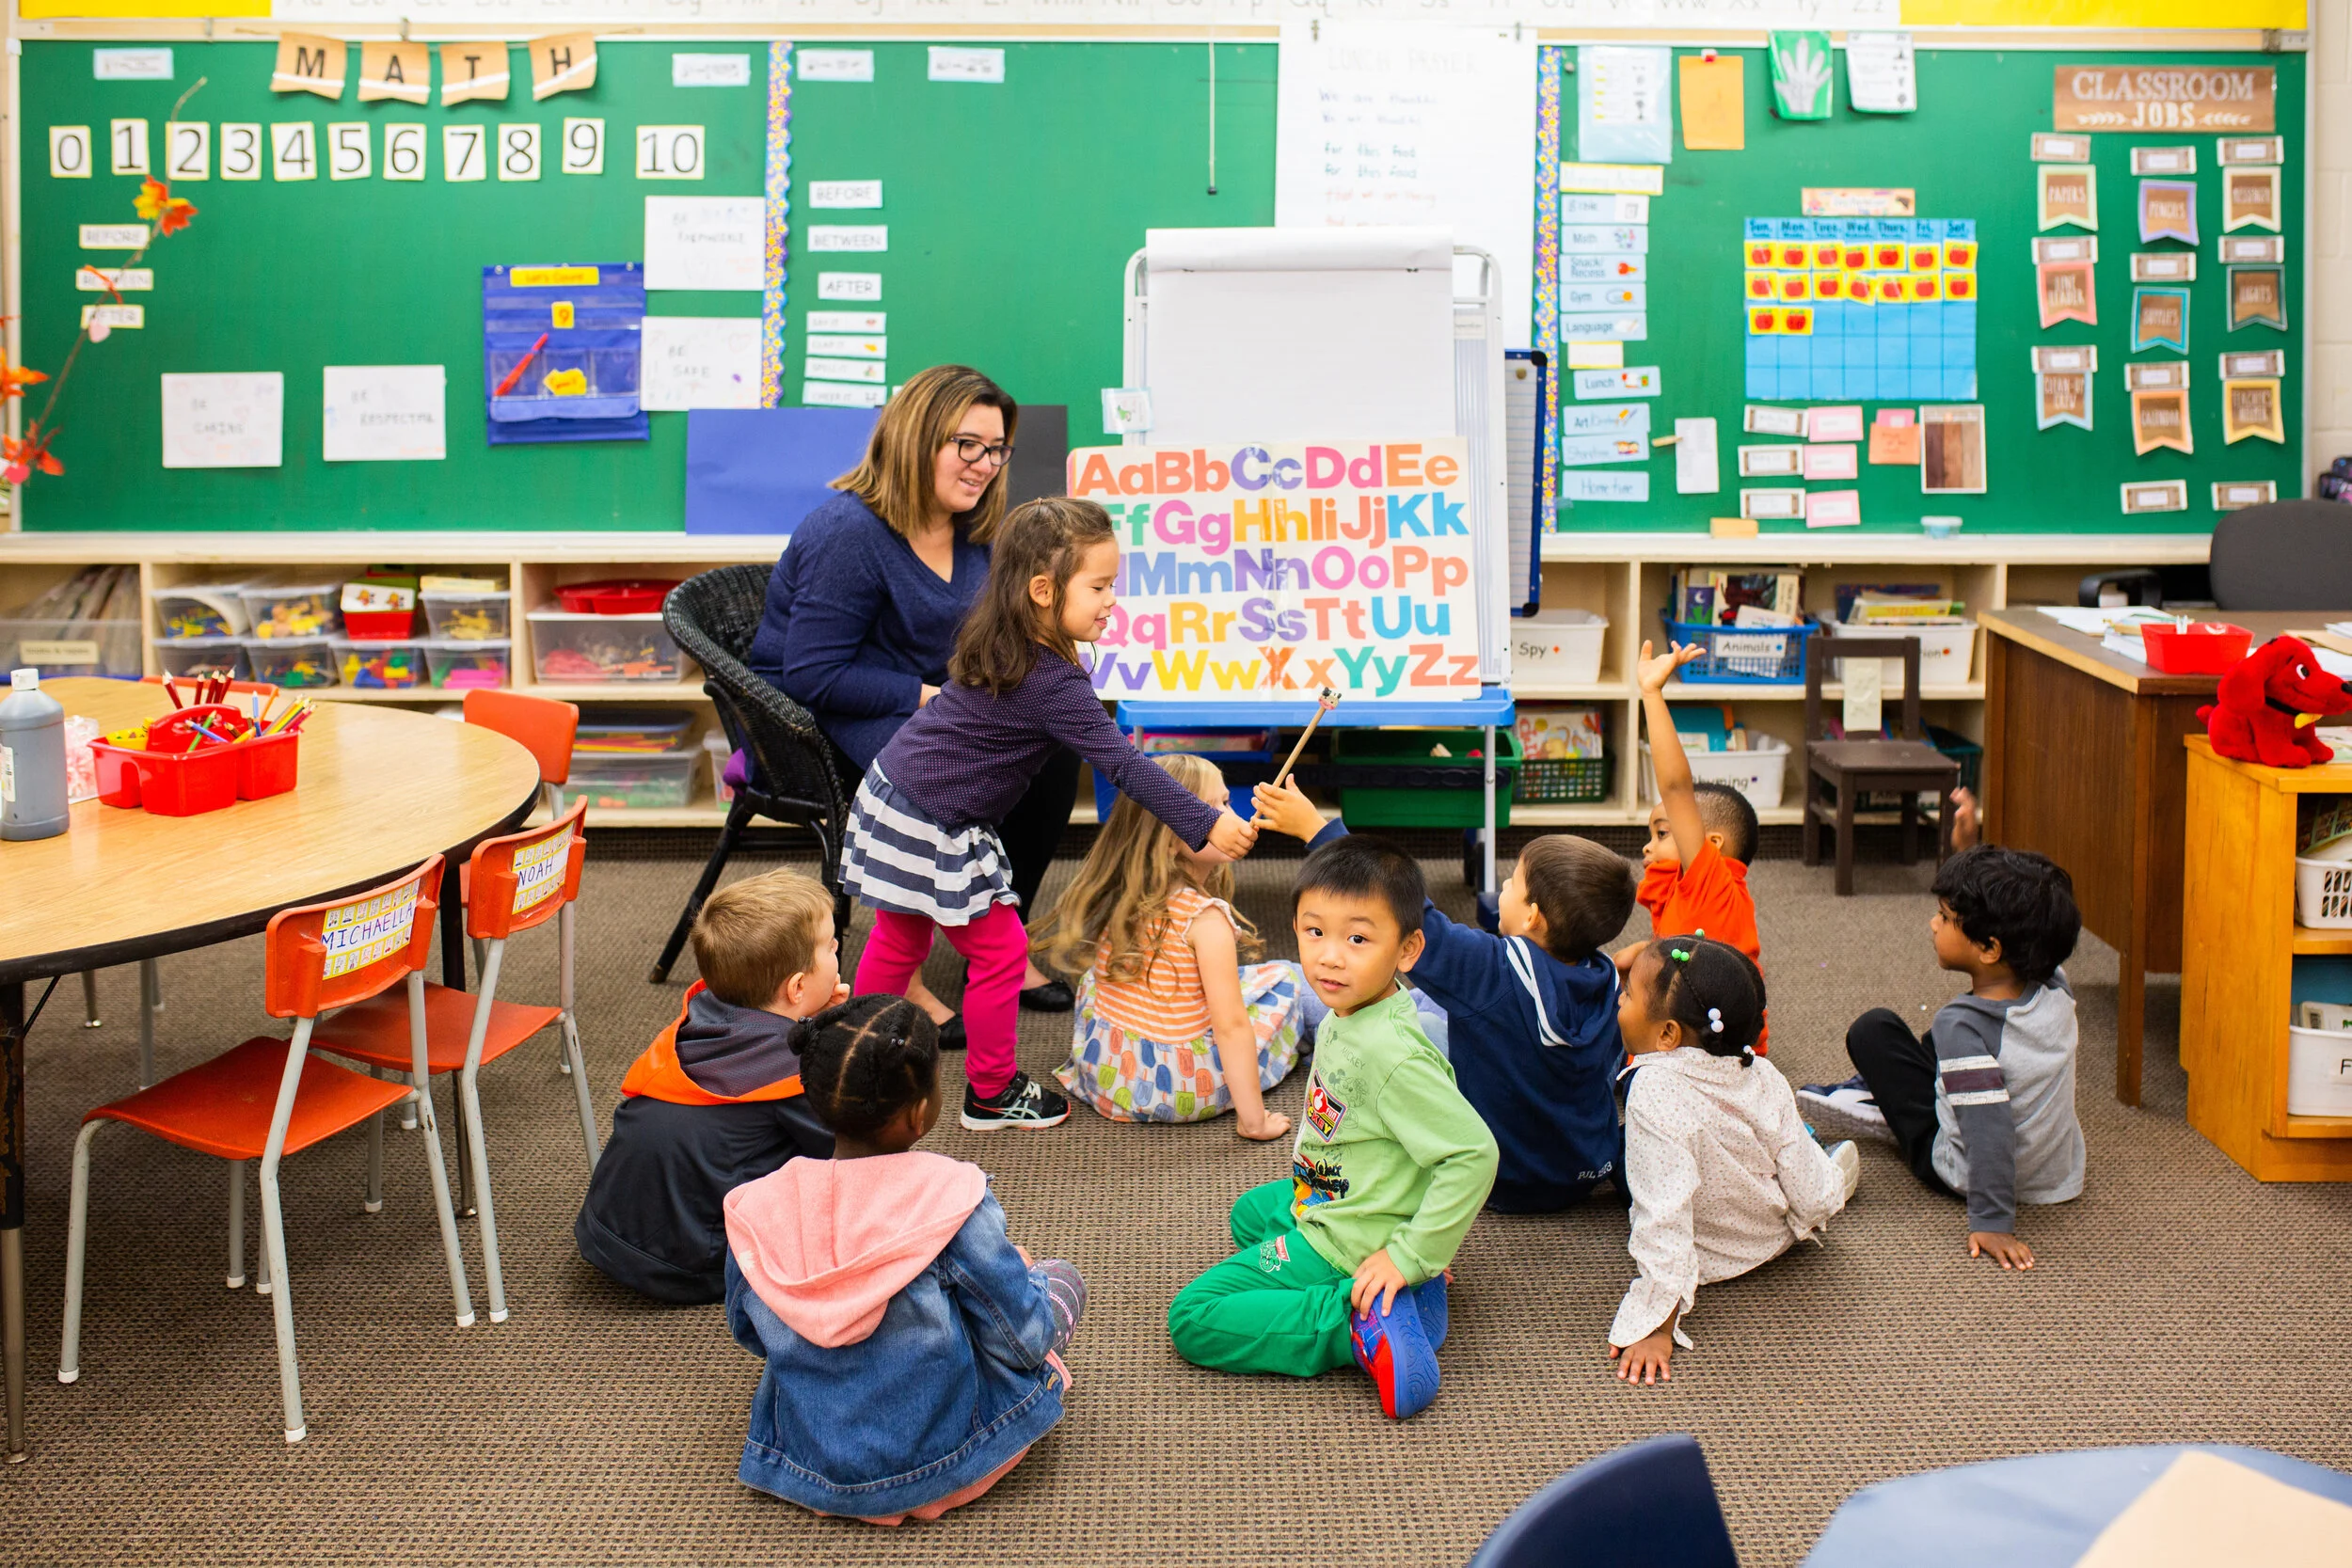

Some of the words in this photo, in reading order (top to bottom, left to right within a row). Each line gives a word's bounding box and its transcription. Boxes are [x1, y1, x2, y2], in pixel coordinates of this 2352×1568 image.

[2072, 71, 2254, 102] CLASSROOM
[2132, 101, 2196, 128] JOBS
[57, 135, 83, 171] 0
[118, 128, 144, 169] 1
[176, 130, 204, 173] 2
[228, 129, 255, 173] 3
[279, 130, 310, 173] 4
[336, 130, 364, 173] 5
[391, 129, 419, 173] 6
[450, 133, 479, 176] 7
[504, 131, 533, 175] 8
[571, 123, 597, 168] 9
[642, 133, 698, 173] 10
[817, 186, 872, 201] BEFORE
[814, 234, 882, 247] BETWEEN
[1573, 232, 1597, 245] Math
[825, 280, 873, 294] AFTER
[1570, 291, 1593, 304] Gym
[558, 308, 570, 325] 9
[1565, 322, 1614, 335] Language
[1585, 376, 1615, 390] Lunch
[1518, 642, 1548, 658] Spy
[1722, 641, 1771, 654] Animals
[517, 855, 554, 887] NOAH
[321, 901, 413, 951] MICHAELLA
[1341, 1046, 1366, 1070] MICKEY
[1326, 1107, 1337, 1121] FUN
